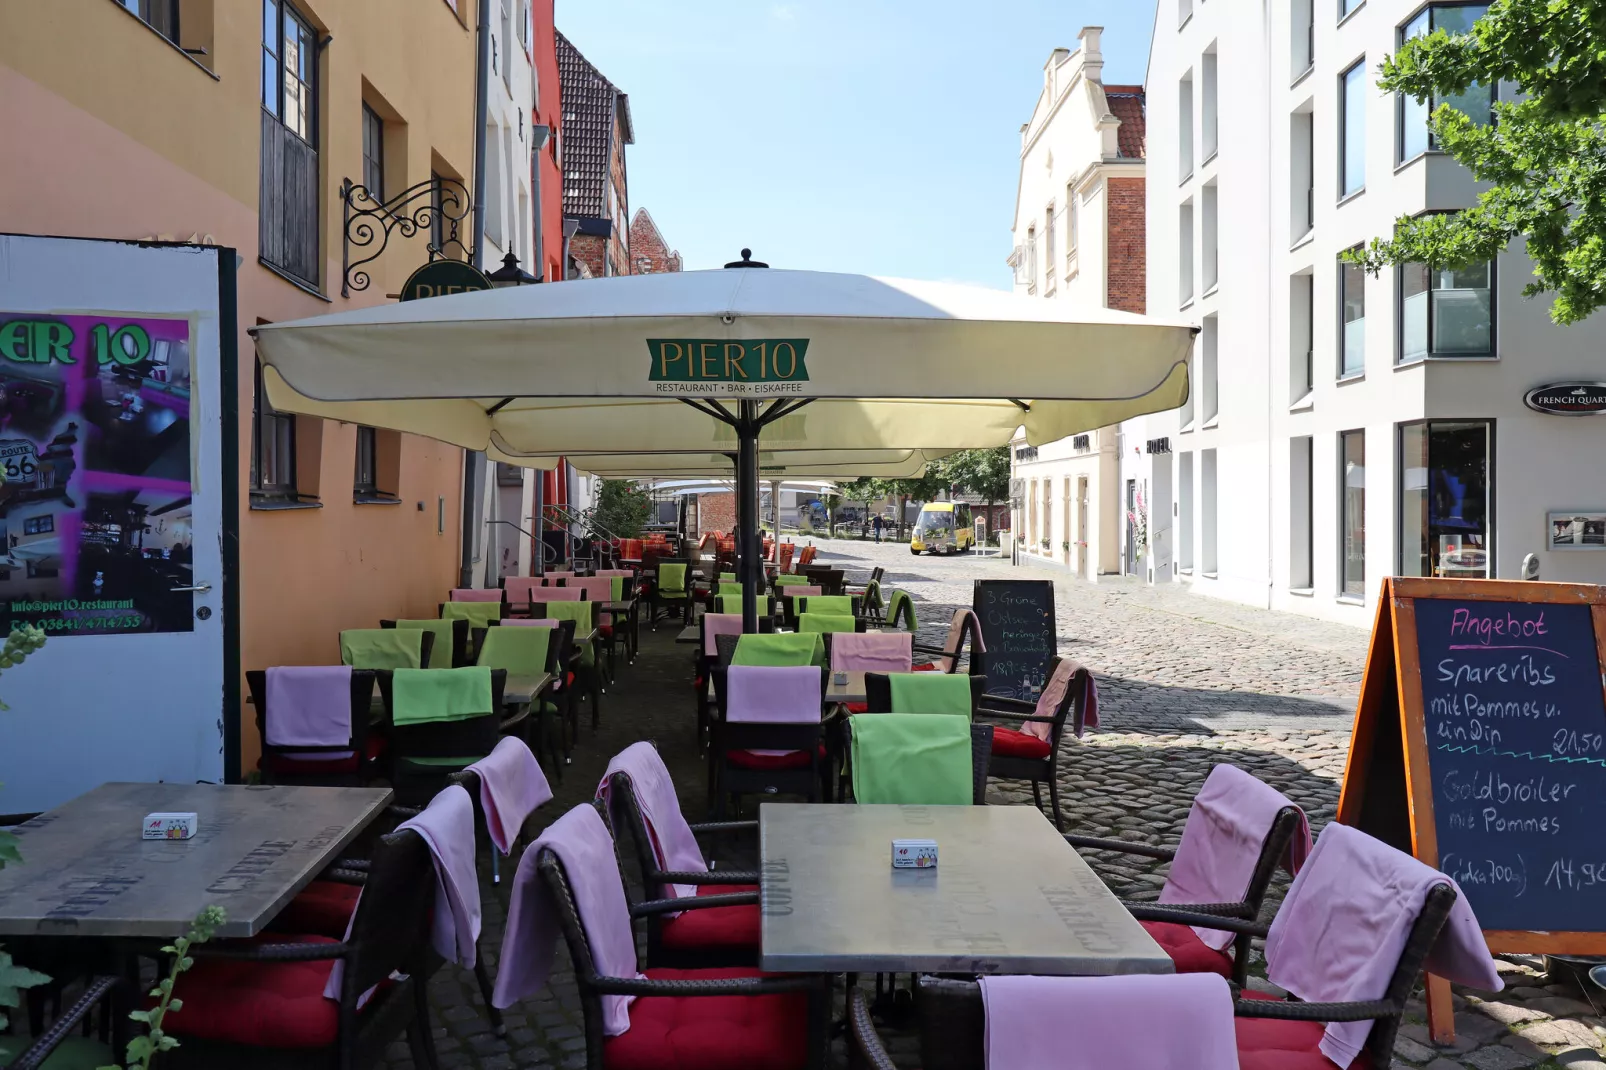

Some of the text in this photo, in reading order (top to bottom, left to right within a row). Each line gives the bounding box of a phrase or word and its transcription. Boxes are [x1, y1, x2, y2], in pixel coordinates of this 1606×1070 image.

[92, 322, 150, 365] 10
[656, 383, 803, 394] RESTAURANT BAR EISKAFFEE
[1538, 396, 1575, 404] FRENCH
[1, 446, 29, 456] ROUTE
[4, 455, 36, 478] 66
[1450, 607, 1549, 646] Angebot
[1430, 693, 1462, 717] mit
[1464, 693, 1541, 720] Pommes
[1552, 728, 1603, 755] 21,50
[1442, 769, 1578, 805] Goldbroiler
[1482, 806, 1561, 836] Pommes
